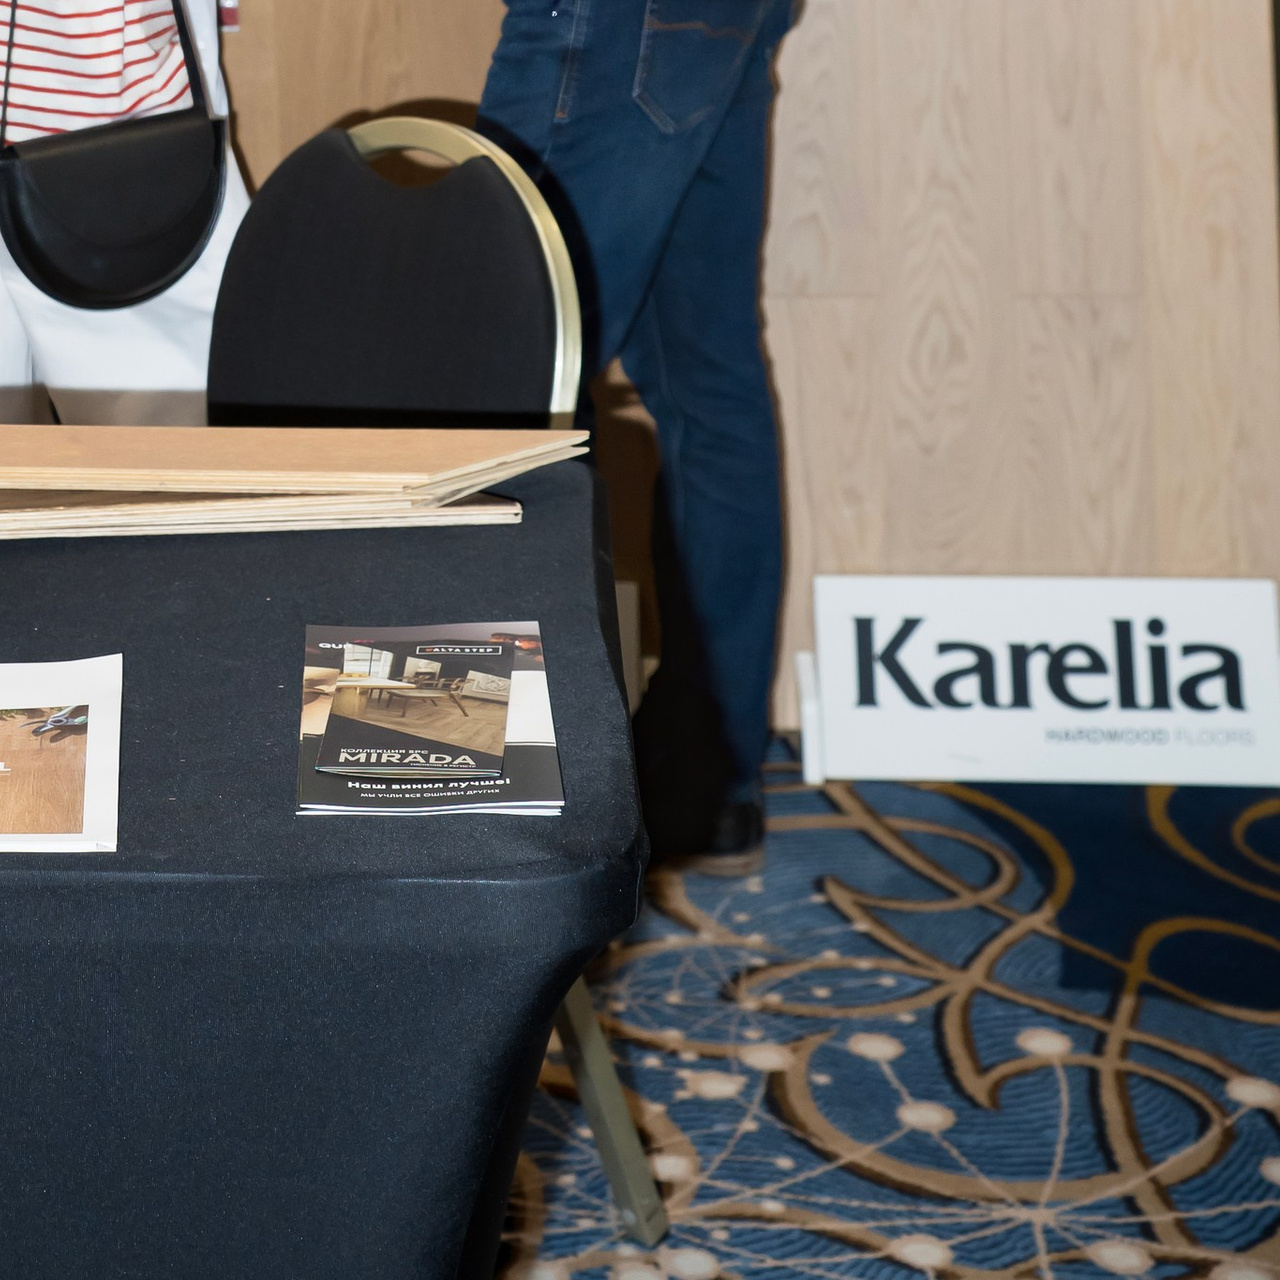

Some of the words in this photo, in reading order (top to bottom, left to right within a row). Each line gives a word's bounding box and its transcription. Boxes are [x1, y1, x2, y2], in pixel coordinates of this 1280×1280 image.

[852, 615, 1250, 712] Karelia
[1045, 727, 1172, 746] HARDWOOD
[338, 752, 477, 765] MIRADA
[347, 781, 387, 790] Наш
[391, 782, 444, 790] винил
[448, 778, 511, 789] лучше!
[423, 790, 465, 798] ОШИБКИ
[466, 788, 500, 796] ДРУГИХ
